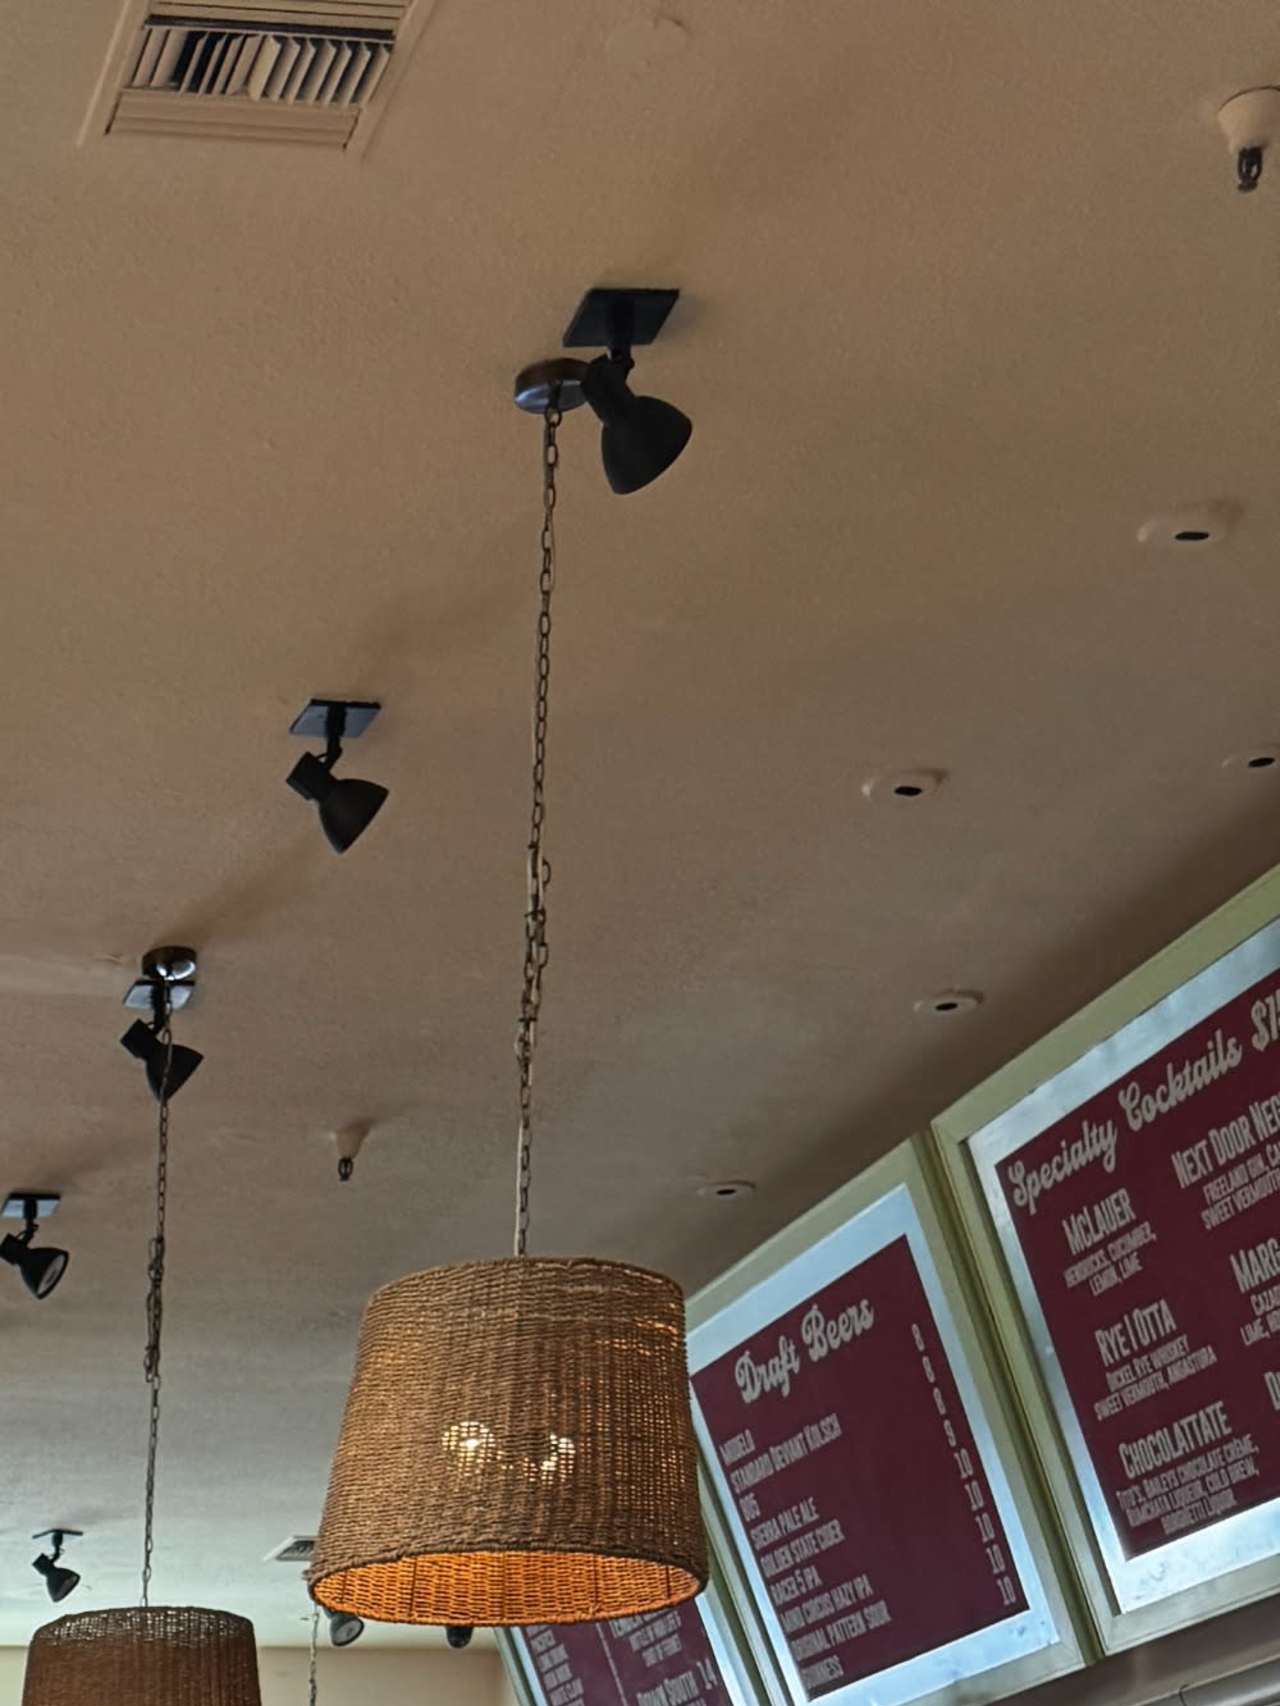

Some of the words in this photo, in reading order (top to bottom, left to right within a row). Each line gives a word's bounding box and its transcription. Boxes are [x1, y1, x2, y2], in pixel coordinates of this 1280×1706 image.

[1008, 1120, 1117, 1215] Specialty
[1118, 1030, 1242, 1131] Cocktails
[1171, 1140, 1213, 1188] NEXT
[1208, 1115, 1256, 1165] DOOR
[1095, 1323, 1130, 1366] RYE
[1133, 1299, 1176, 1346] OTTA
[735, 1336, 800, 1403] Draft
[801, 1299, 873, 1362] Beers
[954, 1448, 973, 1478] 10
[964, 1480, 984, 1511] 10
[975, 1513, 995, 1543] 10
[986, 1544, 1005, 1574] 10
[997, 1576, 1016, 1605] 10
